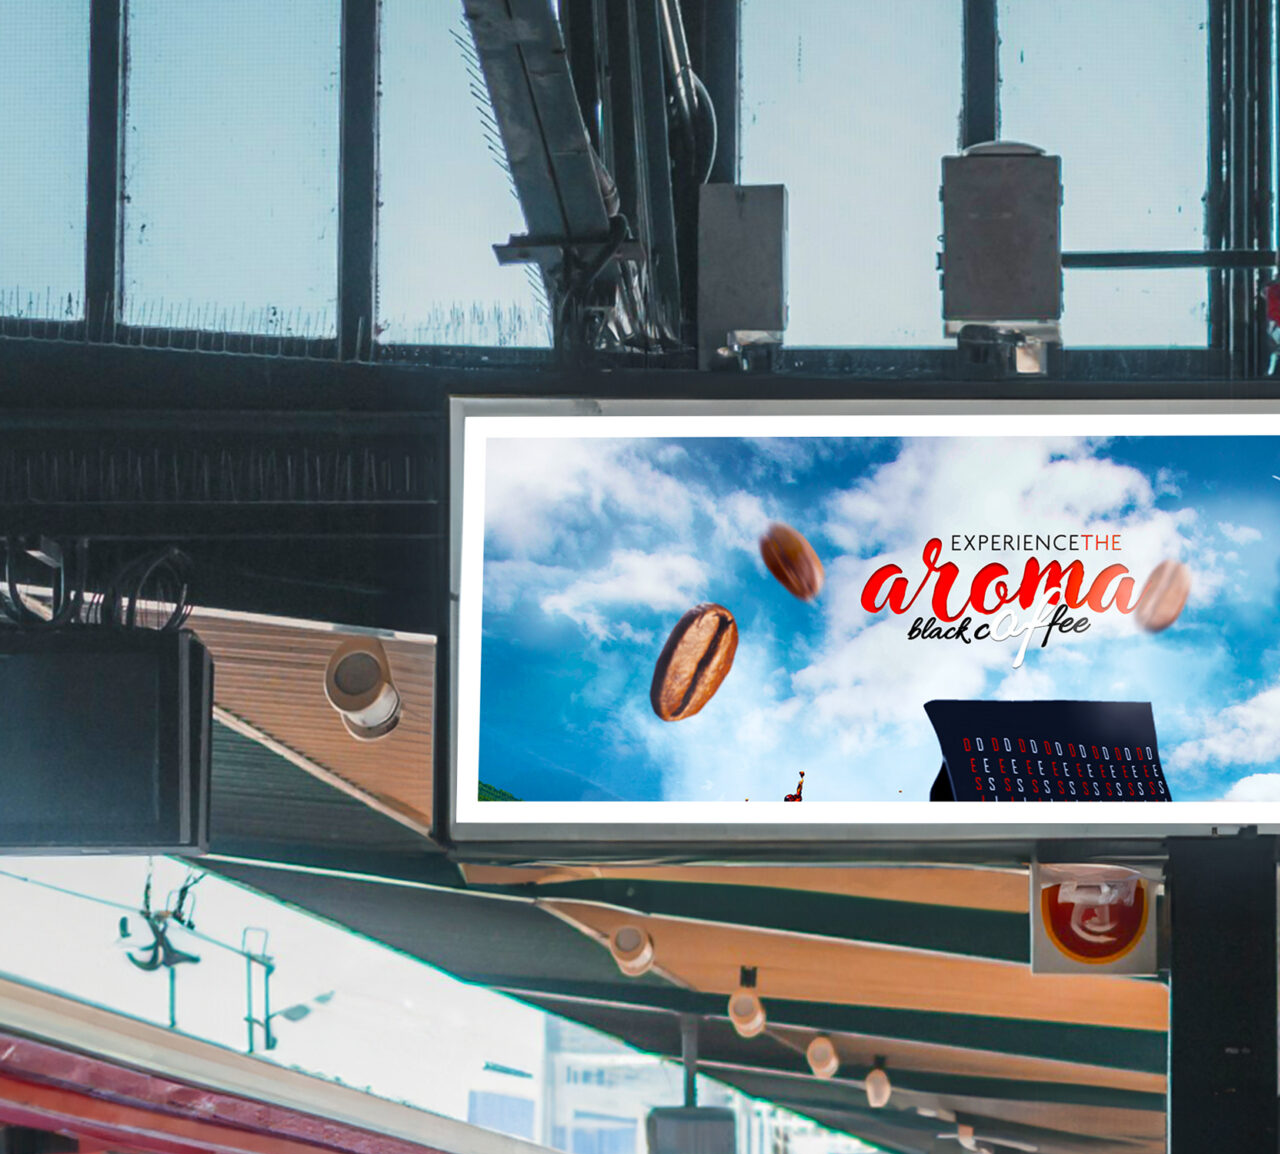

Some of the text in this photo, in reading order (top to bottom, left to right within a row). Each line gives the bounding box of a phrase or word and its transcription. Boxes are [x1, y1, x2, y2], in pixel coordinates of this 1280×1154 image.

[861, 537, 1142, 622] aroma
[907, 587, 1091, 669] black coffee
